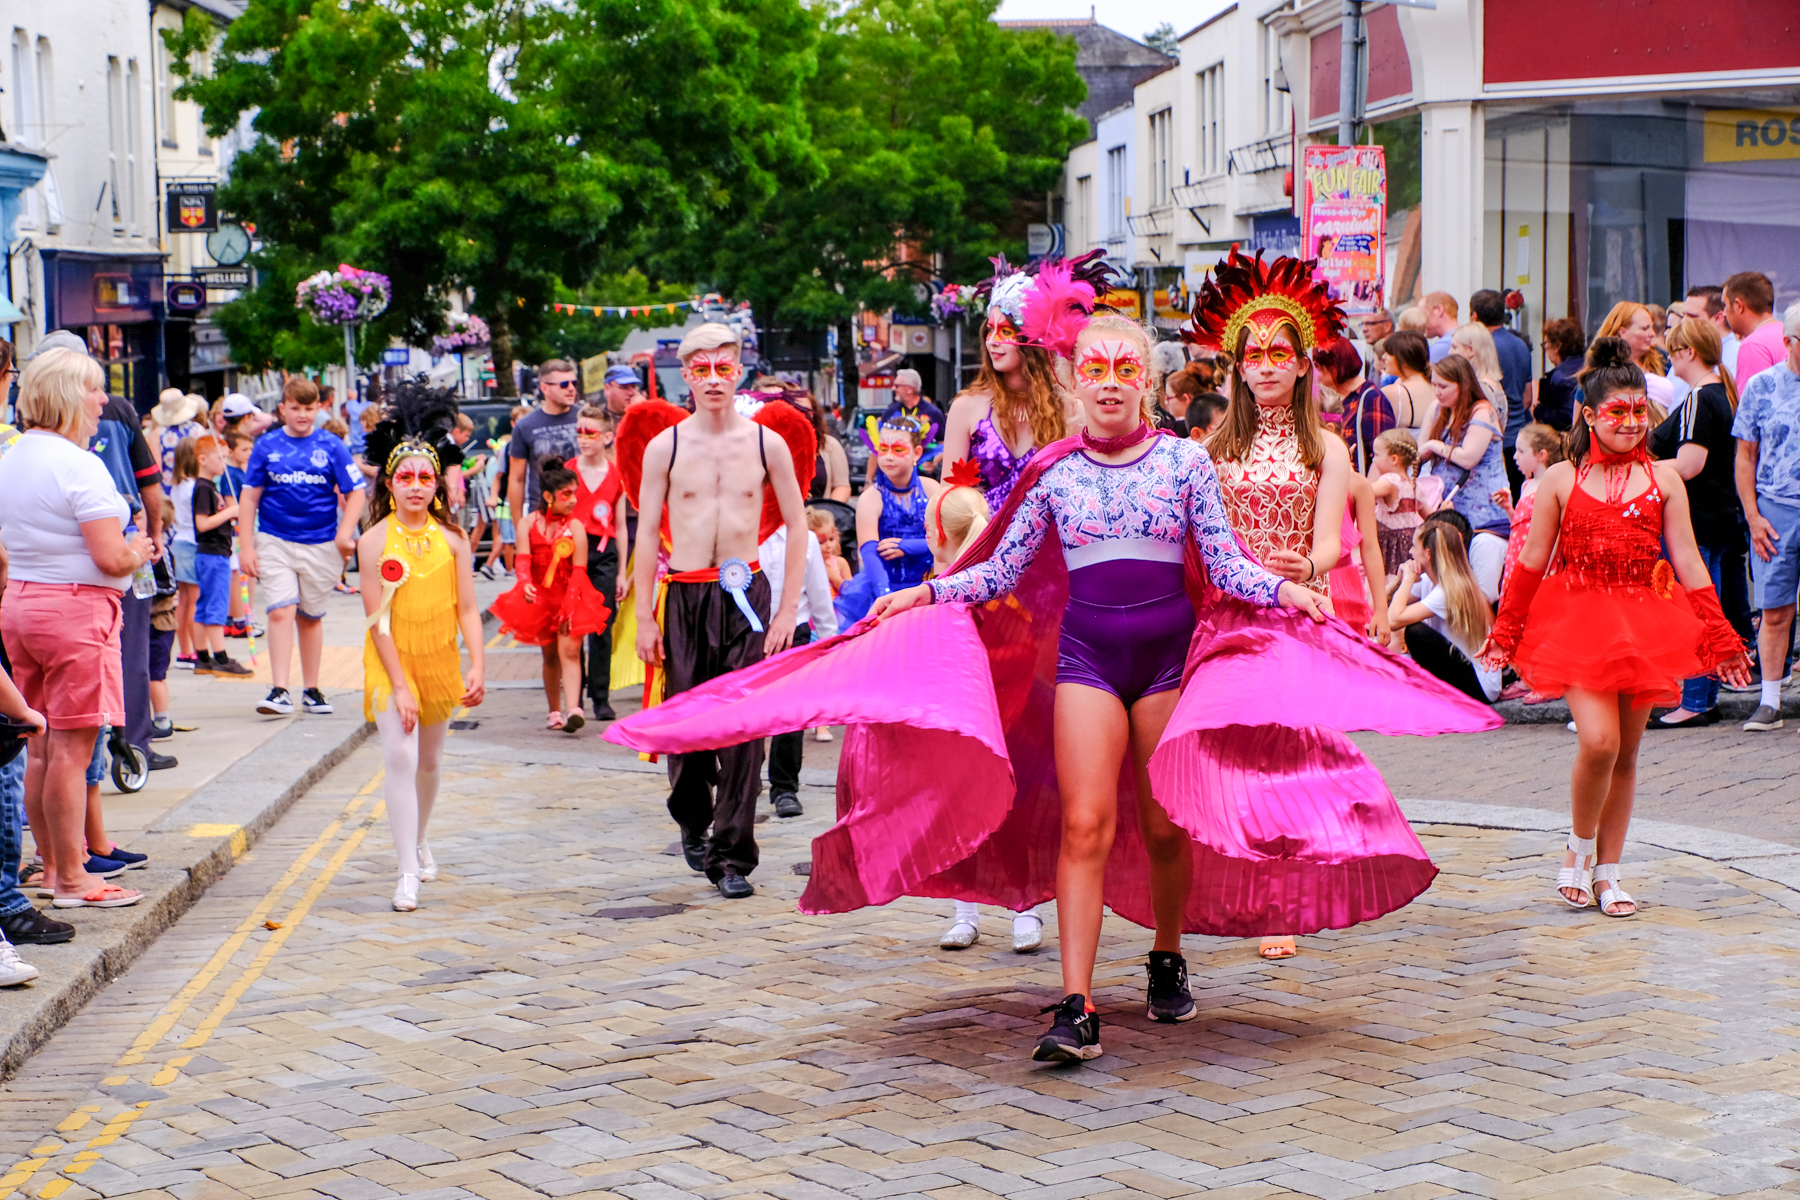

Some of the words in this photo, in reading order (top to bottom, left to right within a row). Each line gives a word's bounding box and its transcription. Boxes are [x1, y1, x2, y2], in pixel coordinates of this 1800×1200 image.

[1313, 164, 1350, 200] FUN
[1351, 168, 1381, 196] FAIR
[1314, 207, 1367, 219] Ross-on-Wye
[1313, 212, 1376, 237] carnival
[194, 273, 248, 284] WELLERS
[268, 470, 327, 485] SportPesa
